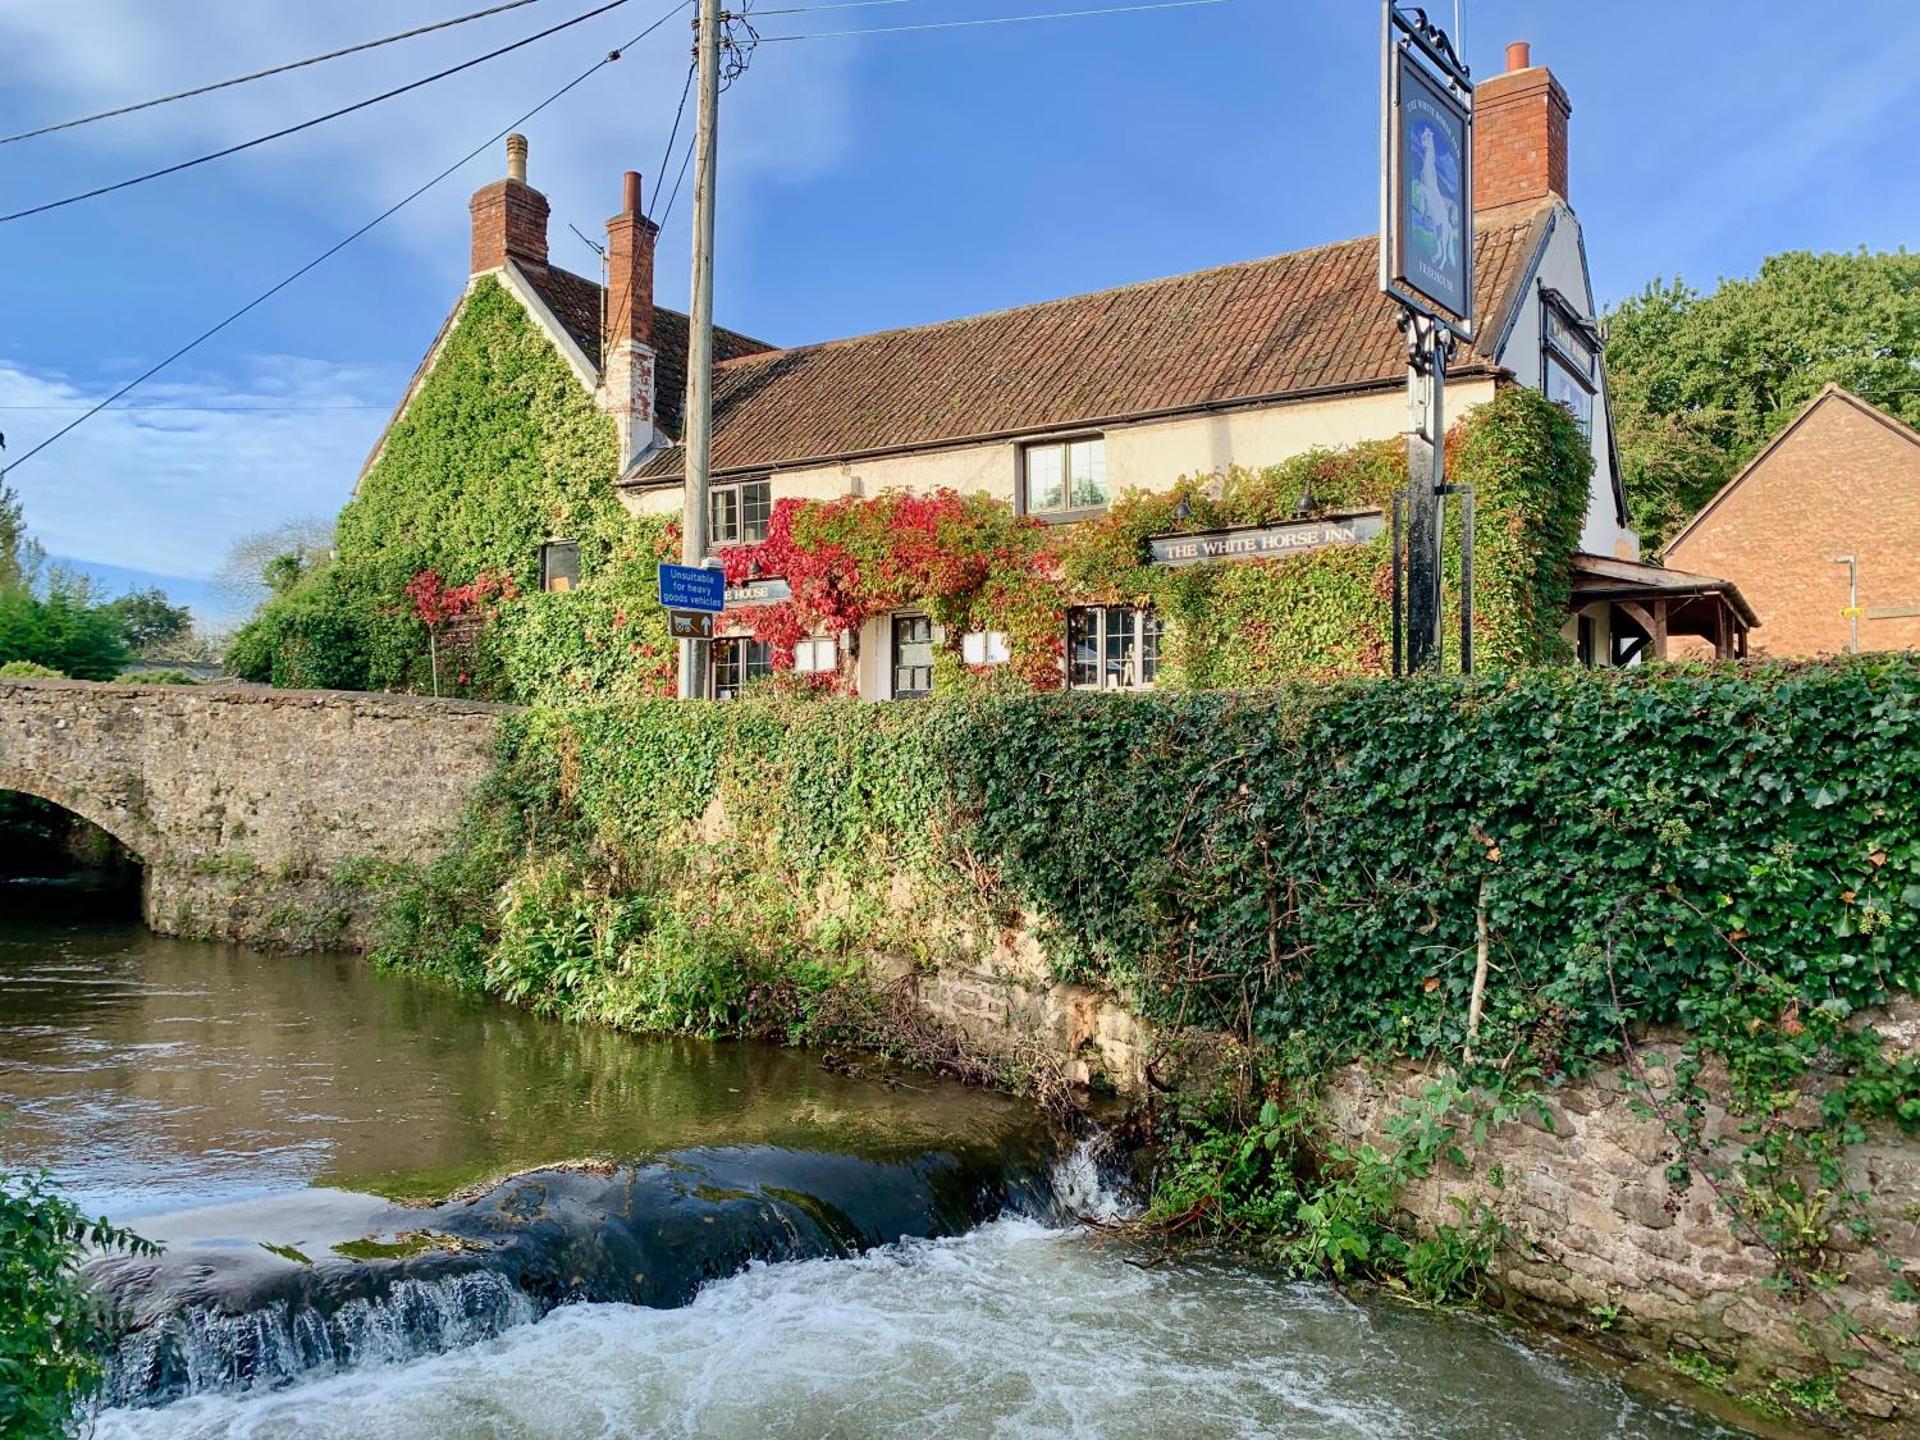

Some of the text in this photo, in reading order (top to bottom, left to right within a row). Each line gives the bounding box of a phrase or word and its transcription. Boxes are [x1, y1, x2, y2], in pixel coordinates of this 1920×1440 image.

[1165, 527, 1356, 559] THE WHITE HORSE INN
[670, 569, 715, 585] Unsuitable
[673, 581, 686, 592] for
[687, 584, 711, 596] heavy
[734, 587, 769, 600] HOUSE
[663, 592, 722, 607] goods vehicles
